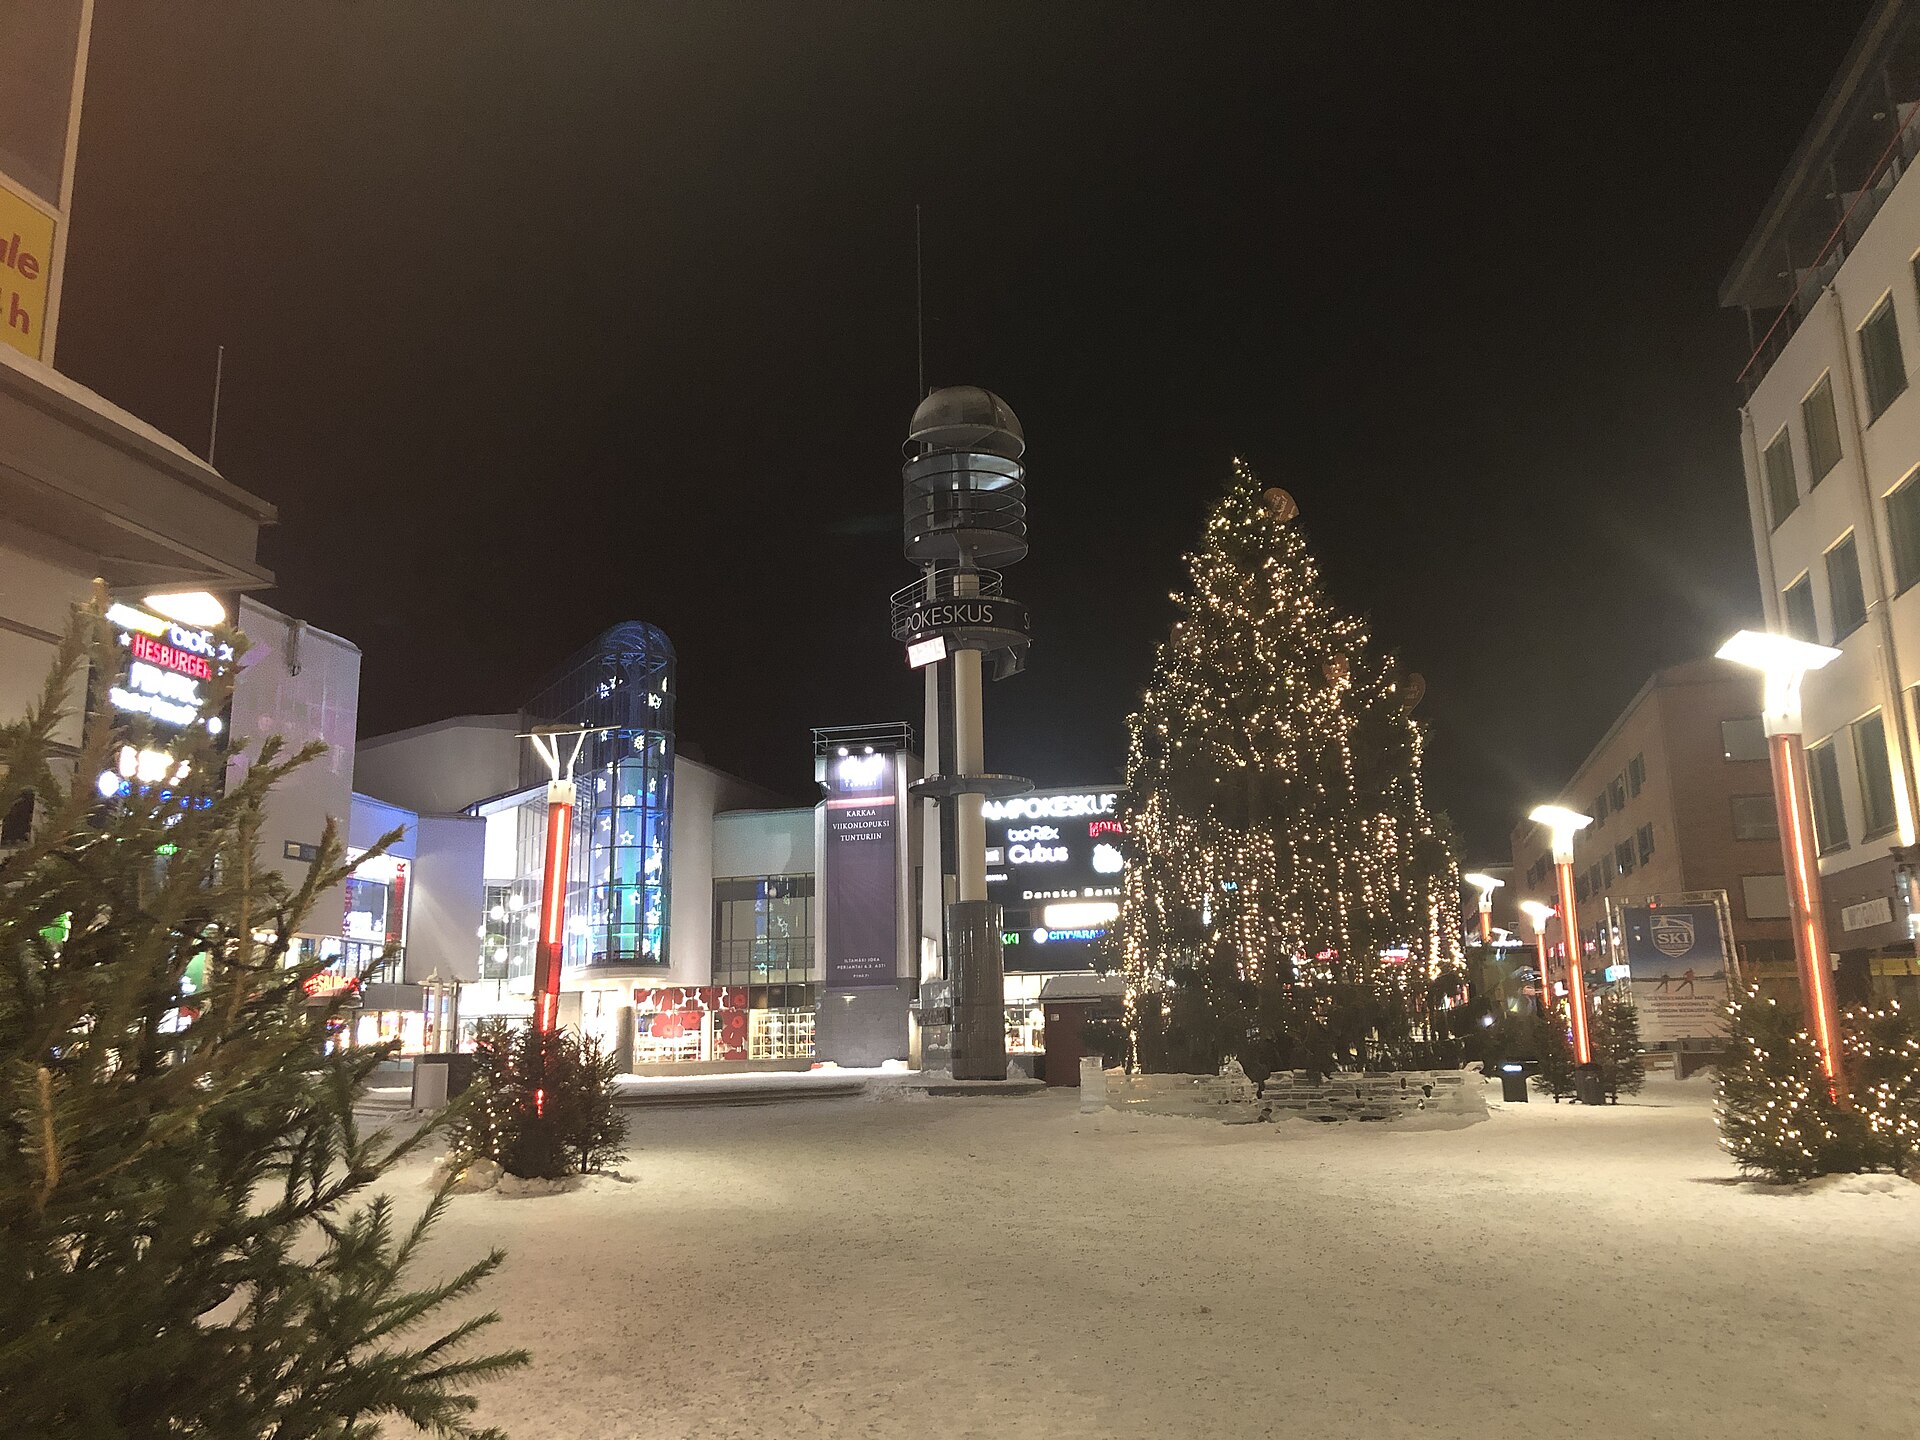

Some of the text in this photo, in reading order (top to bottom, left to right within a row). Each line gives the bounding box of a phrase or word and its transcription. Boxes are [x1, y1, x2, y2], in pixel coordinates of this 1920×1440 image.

[905, 604, 993, 632] POKESKUS
[846, 809, 876, 818] KARKAA
[832, 820, 890, 830] VIIKONLOPUKSI
[840, 832, 882, 842] TUNTURIIN
[1008, 842, 1069, 864] Cubus
[1657, 932, 1690, 944] SKI
